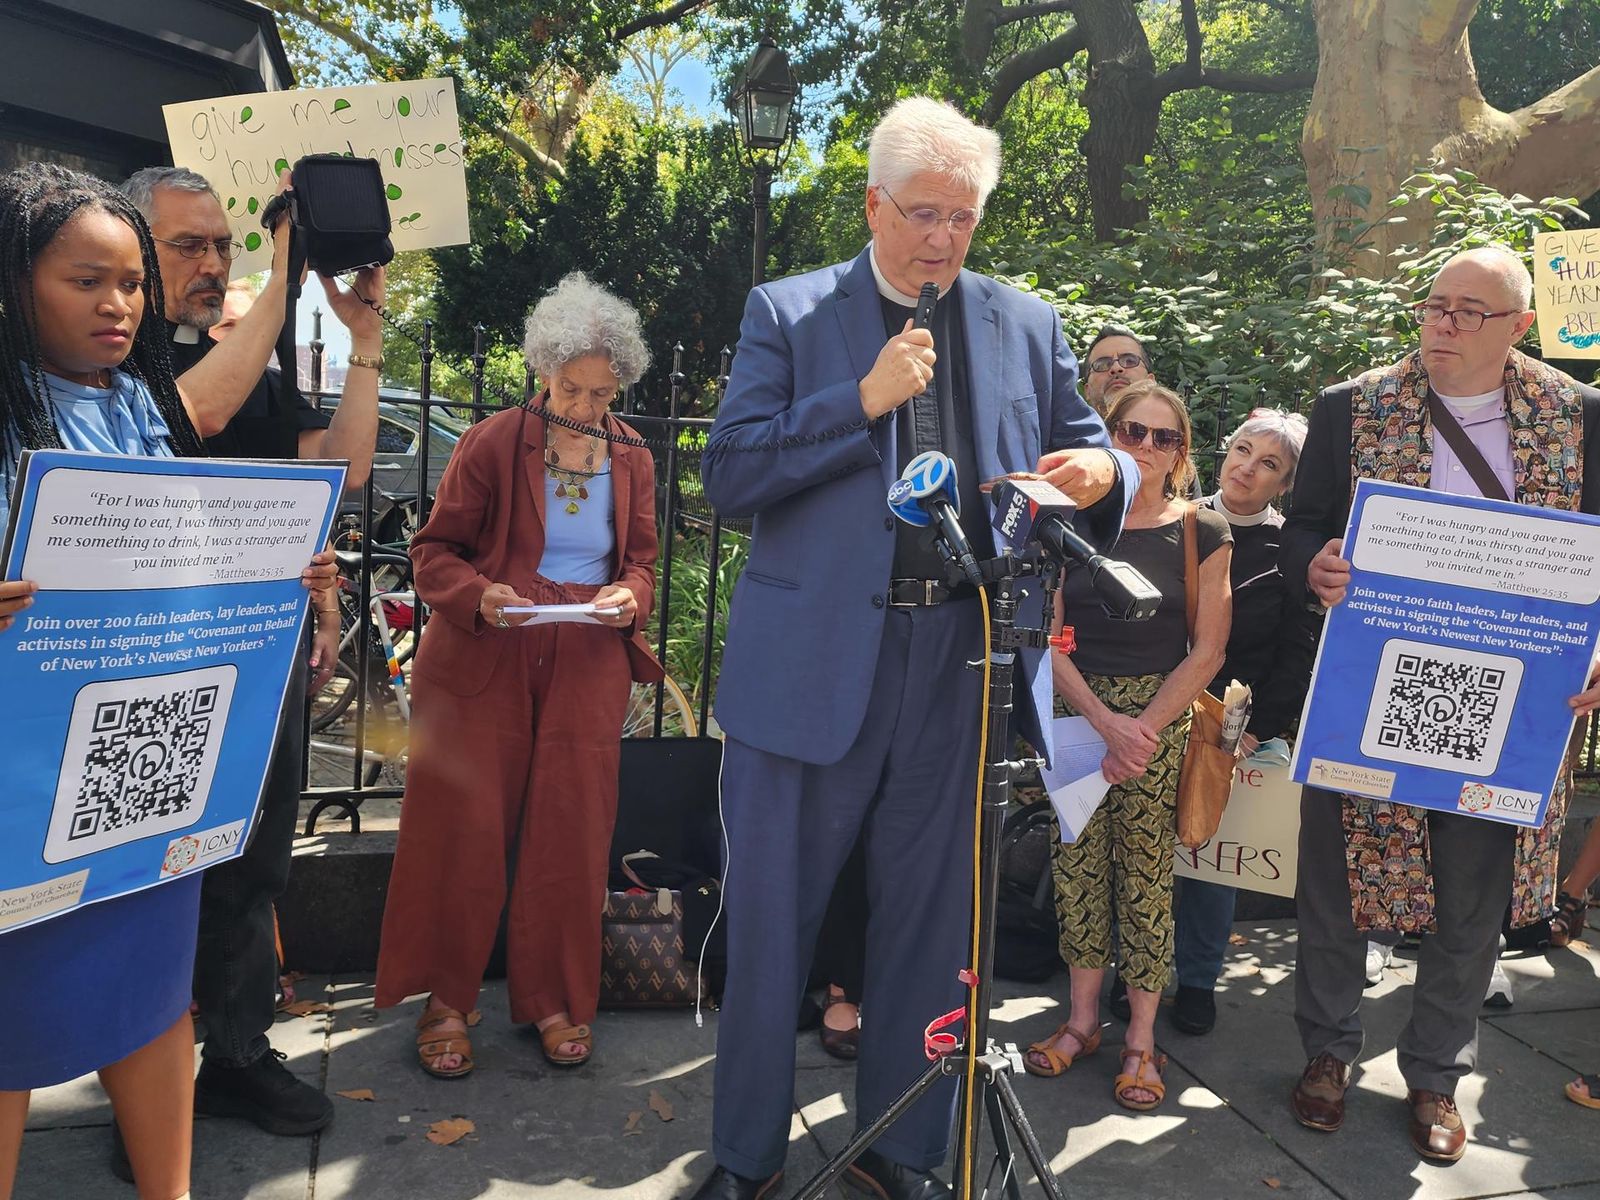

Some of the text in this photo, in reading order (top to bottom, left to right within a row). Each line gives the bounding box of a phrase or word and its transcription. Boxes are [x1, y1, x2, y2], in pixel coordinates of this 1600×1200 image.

[192, 89, 446, 161] give me your
[1544, 233, 1599, 255] GIVE
[90, 492, 296, 512] “For I was hungry and you gave me
[888, 481, 912, 501] abc
[51, 514, 311, 531] something to eat, I was thirsty and you gave
[1001, 491, 1024, 536] FOX 5
[1396, 511, 1577, 546] “For I was hungry and you gave me
[47, 533, 307, 551] me something to drink, I was a stranger and
[1370, 523, 1595, 563] something to eat, I was thirsty and you gave
[132, 552, 243, 571] you invited me in.”
[1367, 537, 1384, 545] me
[1386, 539, 1439, 556] something
[1441, 547, 1452, 556] to
[1453, 549, 1484, 562] drink,
[1486, 553, 1492, 562] I
[1493, 556, 1513, 566] was
[1524, 561, 1568, 573] stranger
[1570, 567, 1592, 577] and
[1425, 559, 1525, 580] you invited me in.”
[259, 567, 285, 577] 25:35
[1542, 588, 1569, 599] 25:35
[24, 599, 298, 633] Join over 200 faith leaders, lay leaders, and
[1353, 586, 1588, 632] Join over 200 faith leaders, lay leaders, and
[17, 615, 297, 651] activists in signing the “Covenant on Behalf
[1348, 600, 1588, 646] activists in signing the “Covenant on Behalf
[1363, 616, 1563, 656] of New York’s Newest New Yorkers”:
[40, 657, 59, 672] of
[60, 658, 97, 671] New
[99, 652, 145, 669] York’s
[147, 648, 193, 664] Newest
[194, 645, 220, 658] New
[1331, 767, 1391, 783] New York State
[1496, 794, 1540, 811] ICNY
[202, 828, 243, 853] ICNY
[1, 880, 82, 908] New York State
